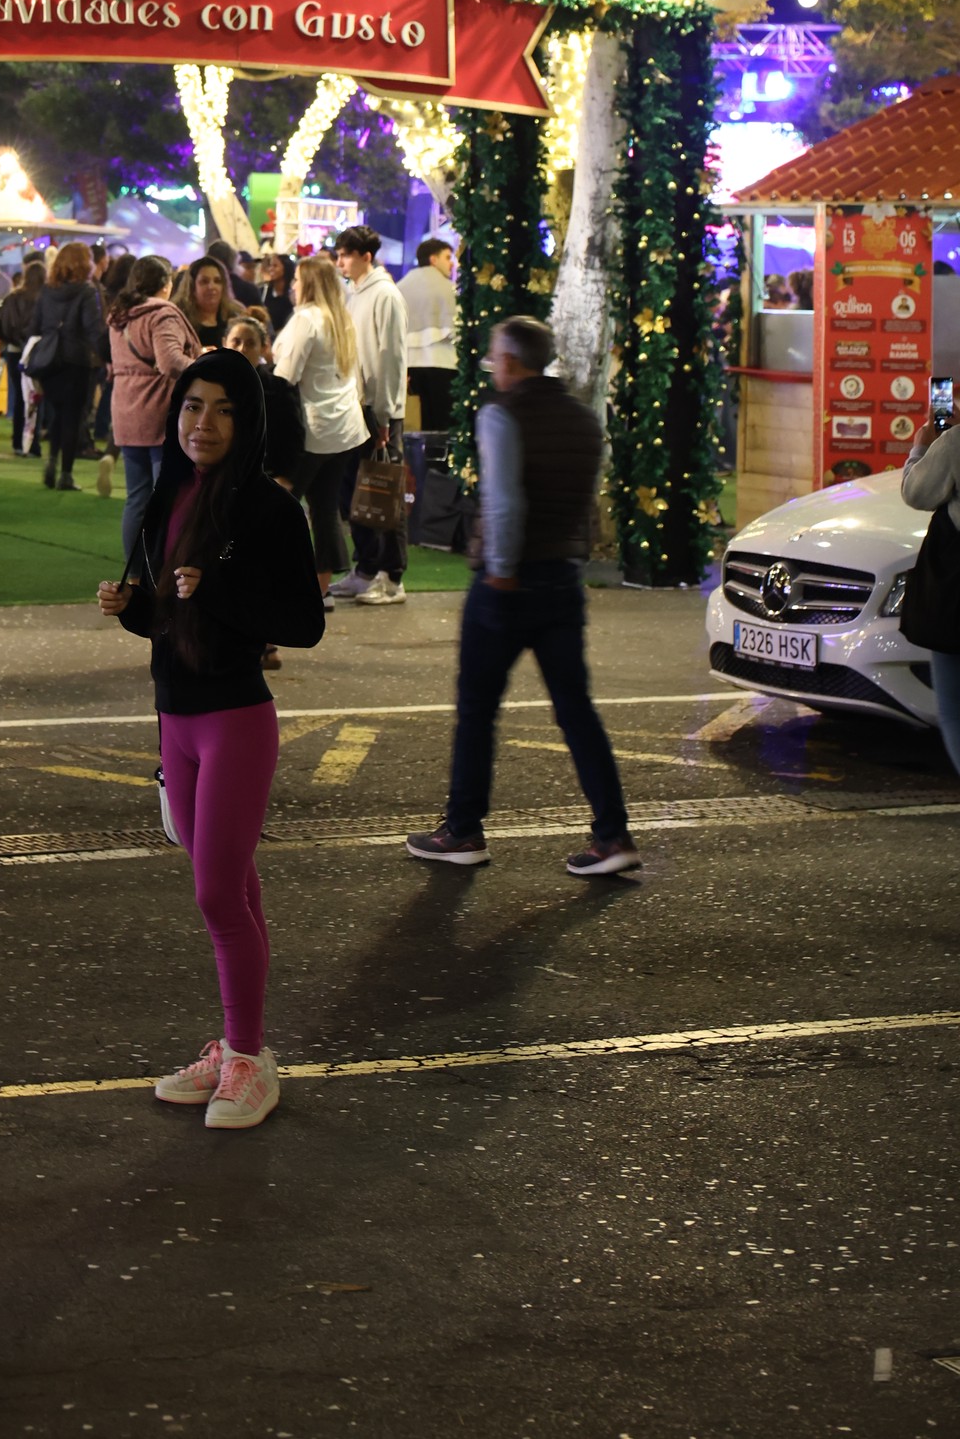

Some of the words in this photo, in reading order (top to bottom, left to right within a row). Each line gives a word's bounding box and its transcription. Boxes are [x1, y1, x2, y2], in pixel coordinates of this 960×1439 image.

[200, 2, 274, 32] con
[294, 0, 426, 48] Gusto
[899, 230, 916, 248] 06
[741, 627, 774, 655] 2326
[778, 634, 812, 662] HSK
